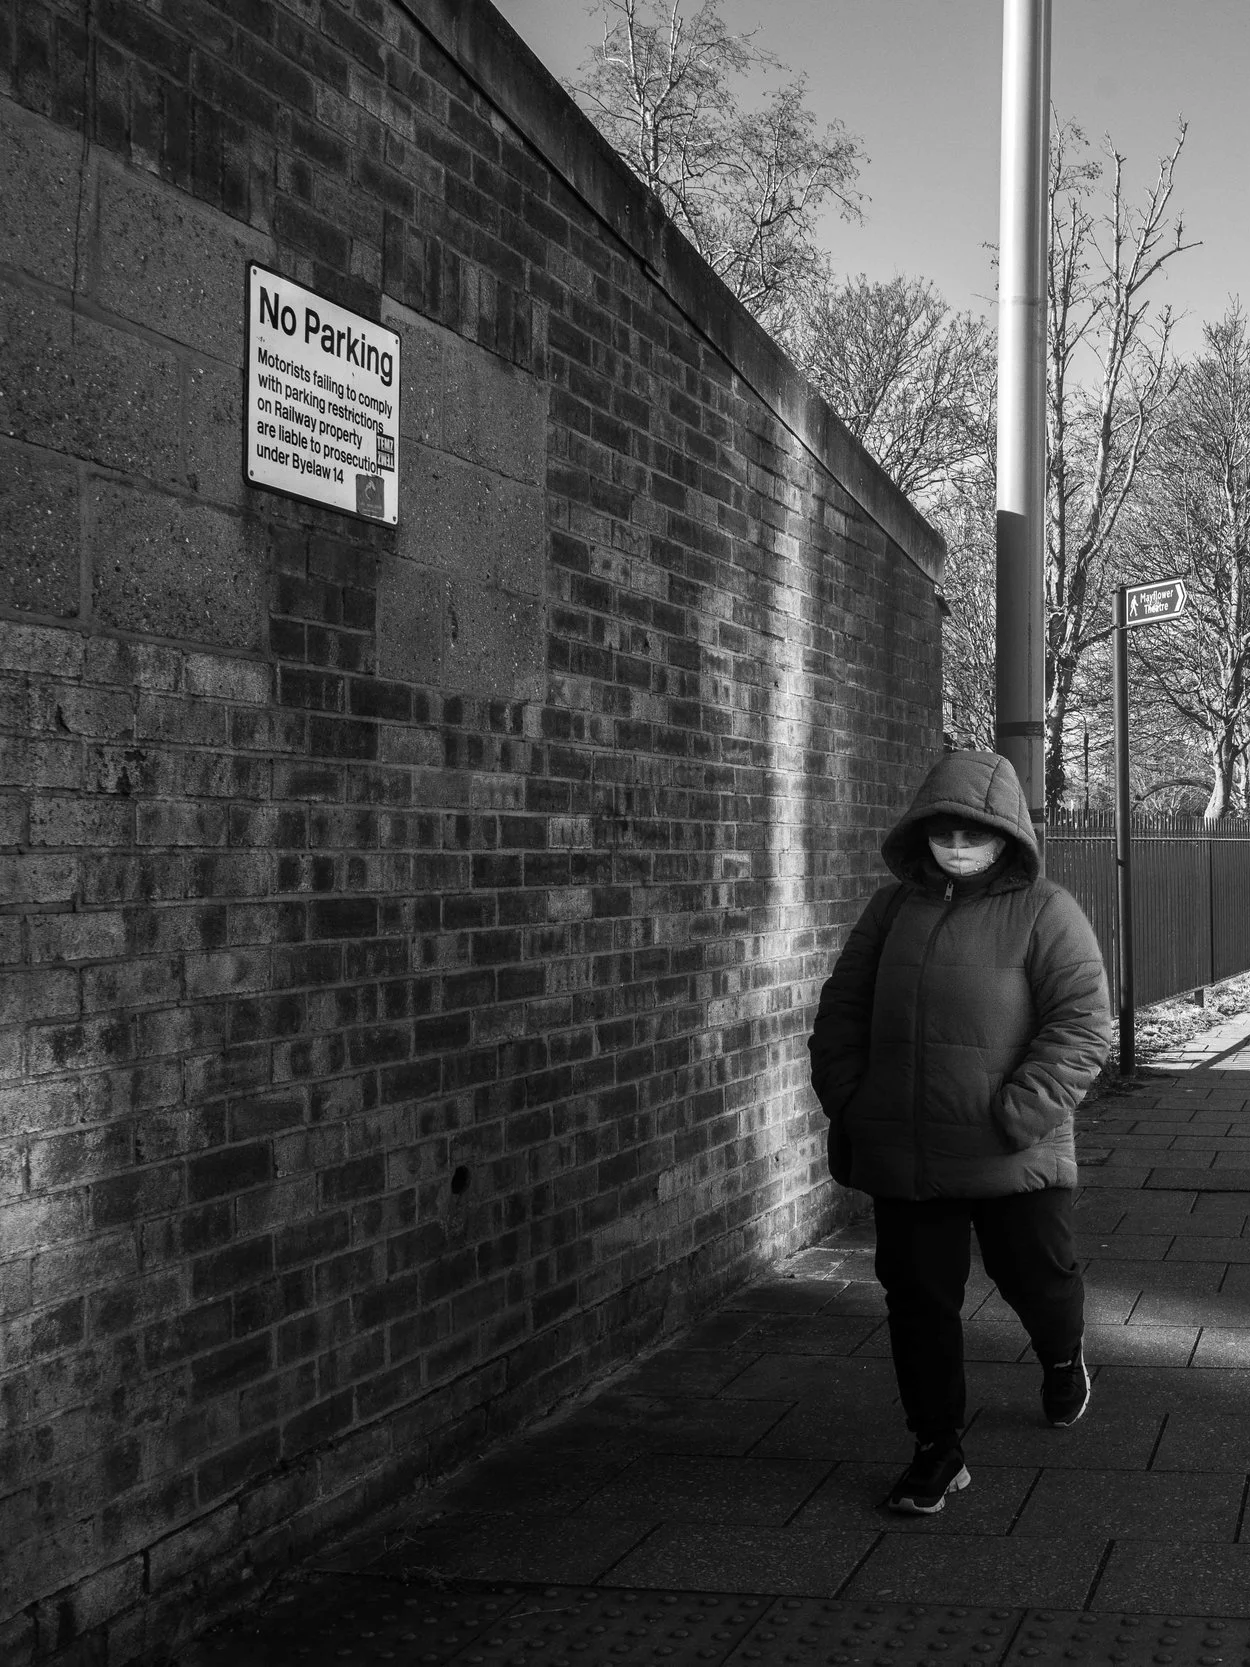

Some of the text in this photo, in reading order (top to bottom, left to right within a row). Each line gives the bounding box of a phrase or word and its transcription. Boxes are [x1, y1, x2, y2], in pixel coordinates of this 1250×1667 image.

[259, 285, 394, 388] No Parking
[257, 347, 393, 420] Motorists failing to comply
[257, 373, 385, 435] with parking restrictions
[256, 420, 276, 438] are
[278, 424, 308, 450] liable
[310, 435, 322, 454] to
[257, 397, 363, 450] on Railway property
[256, 443, 345, 484] under Byelaw 14
[1140, 589, 1174, 606] Mayflower
[1144, 602, 1169, 614] Theatre
